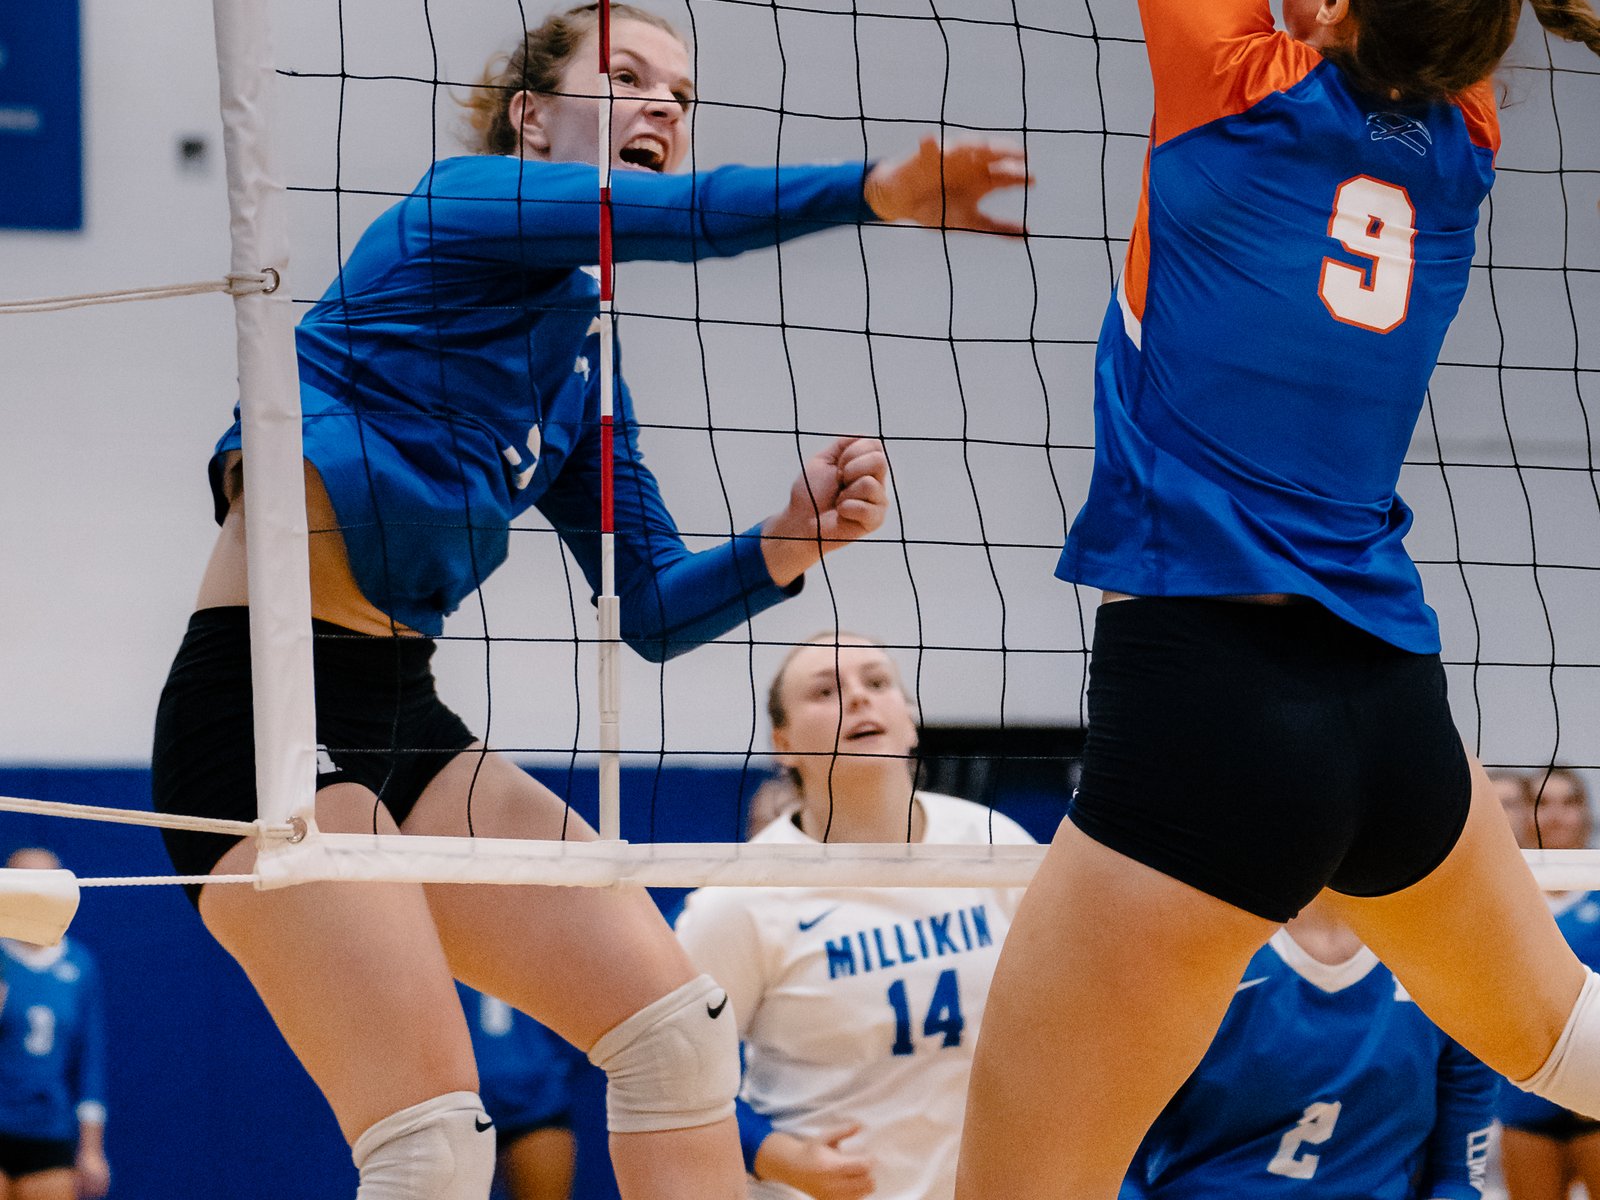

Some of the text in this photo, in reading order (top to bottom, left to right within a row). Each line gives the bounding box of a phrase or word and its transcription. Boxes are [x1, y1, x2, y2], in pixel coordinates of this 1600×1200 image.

[1318, 173, 1419, 335] 9
[825, 904, 994, 980] MILLIKIN
[887, 967, 965, 1056] 14
[1266, 1100, 1342, 1180] 2
